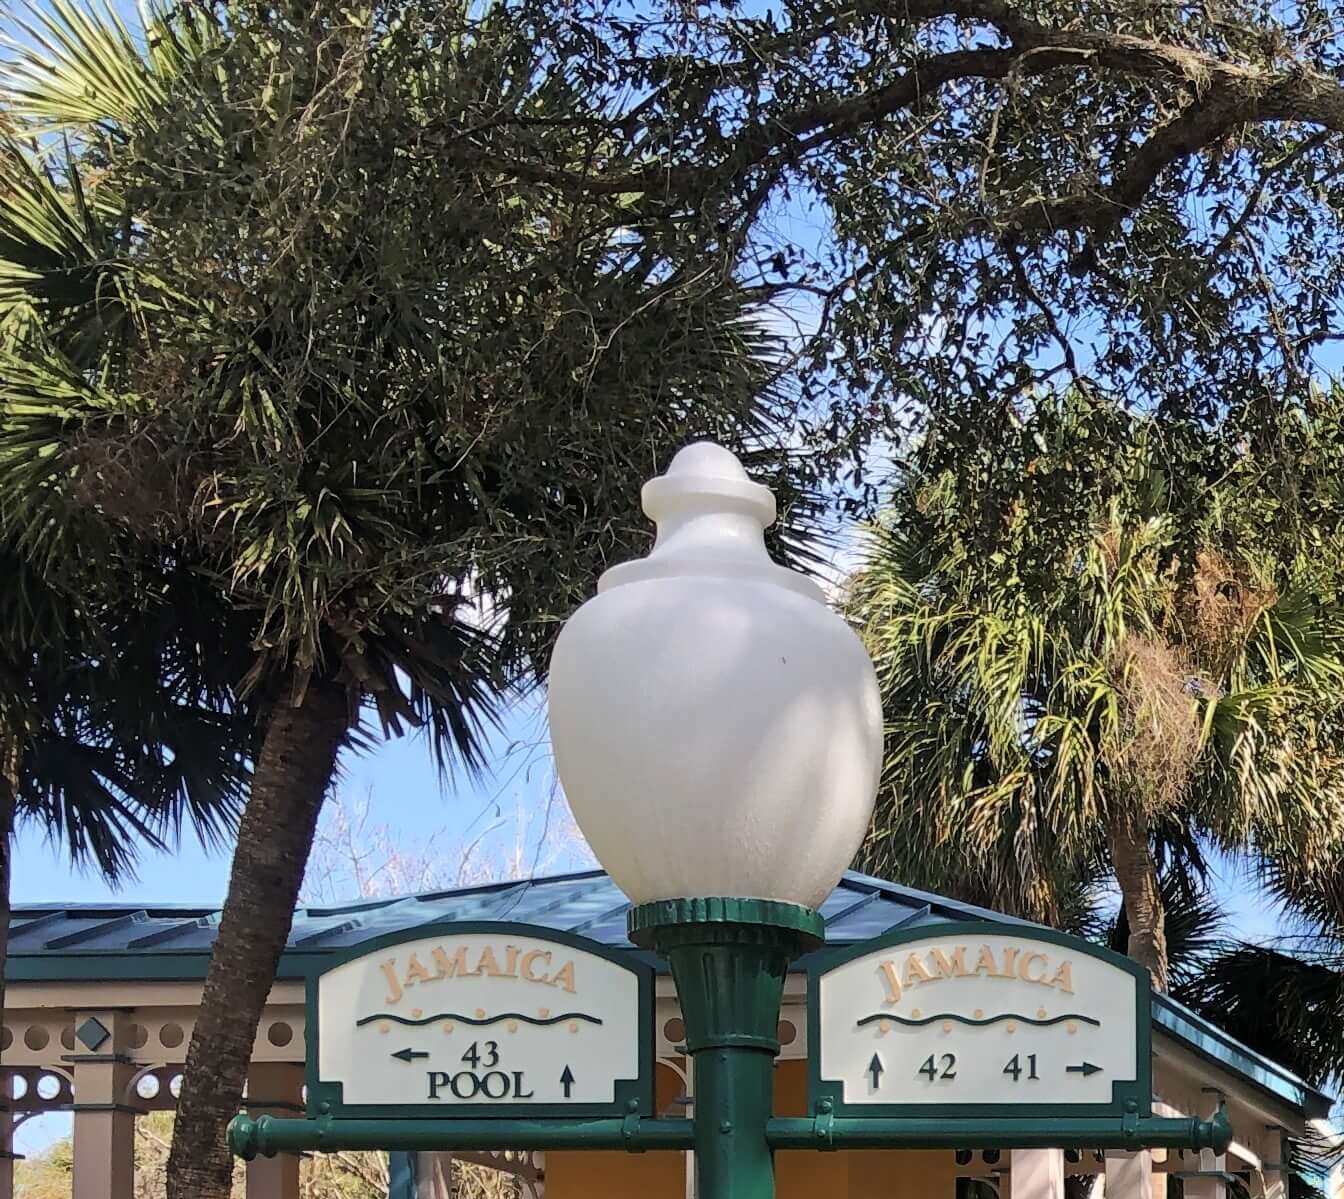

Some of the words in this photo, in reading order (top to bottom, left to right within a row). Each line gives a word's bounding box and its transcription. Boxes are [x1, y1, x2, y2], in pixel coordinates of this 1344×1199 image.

[380, 944, 577, 1005] JAMAICA
[879, 944, 1075, 1004] JAMAICA
[460, 1040, 500, 1069] 43
[918, 1053, 957, 1082] 42
[1002, 1053, 1041, 1082] 41
[426, 1071, 535, 1099] POOL
